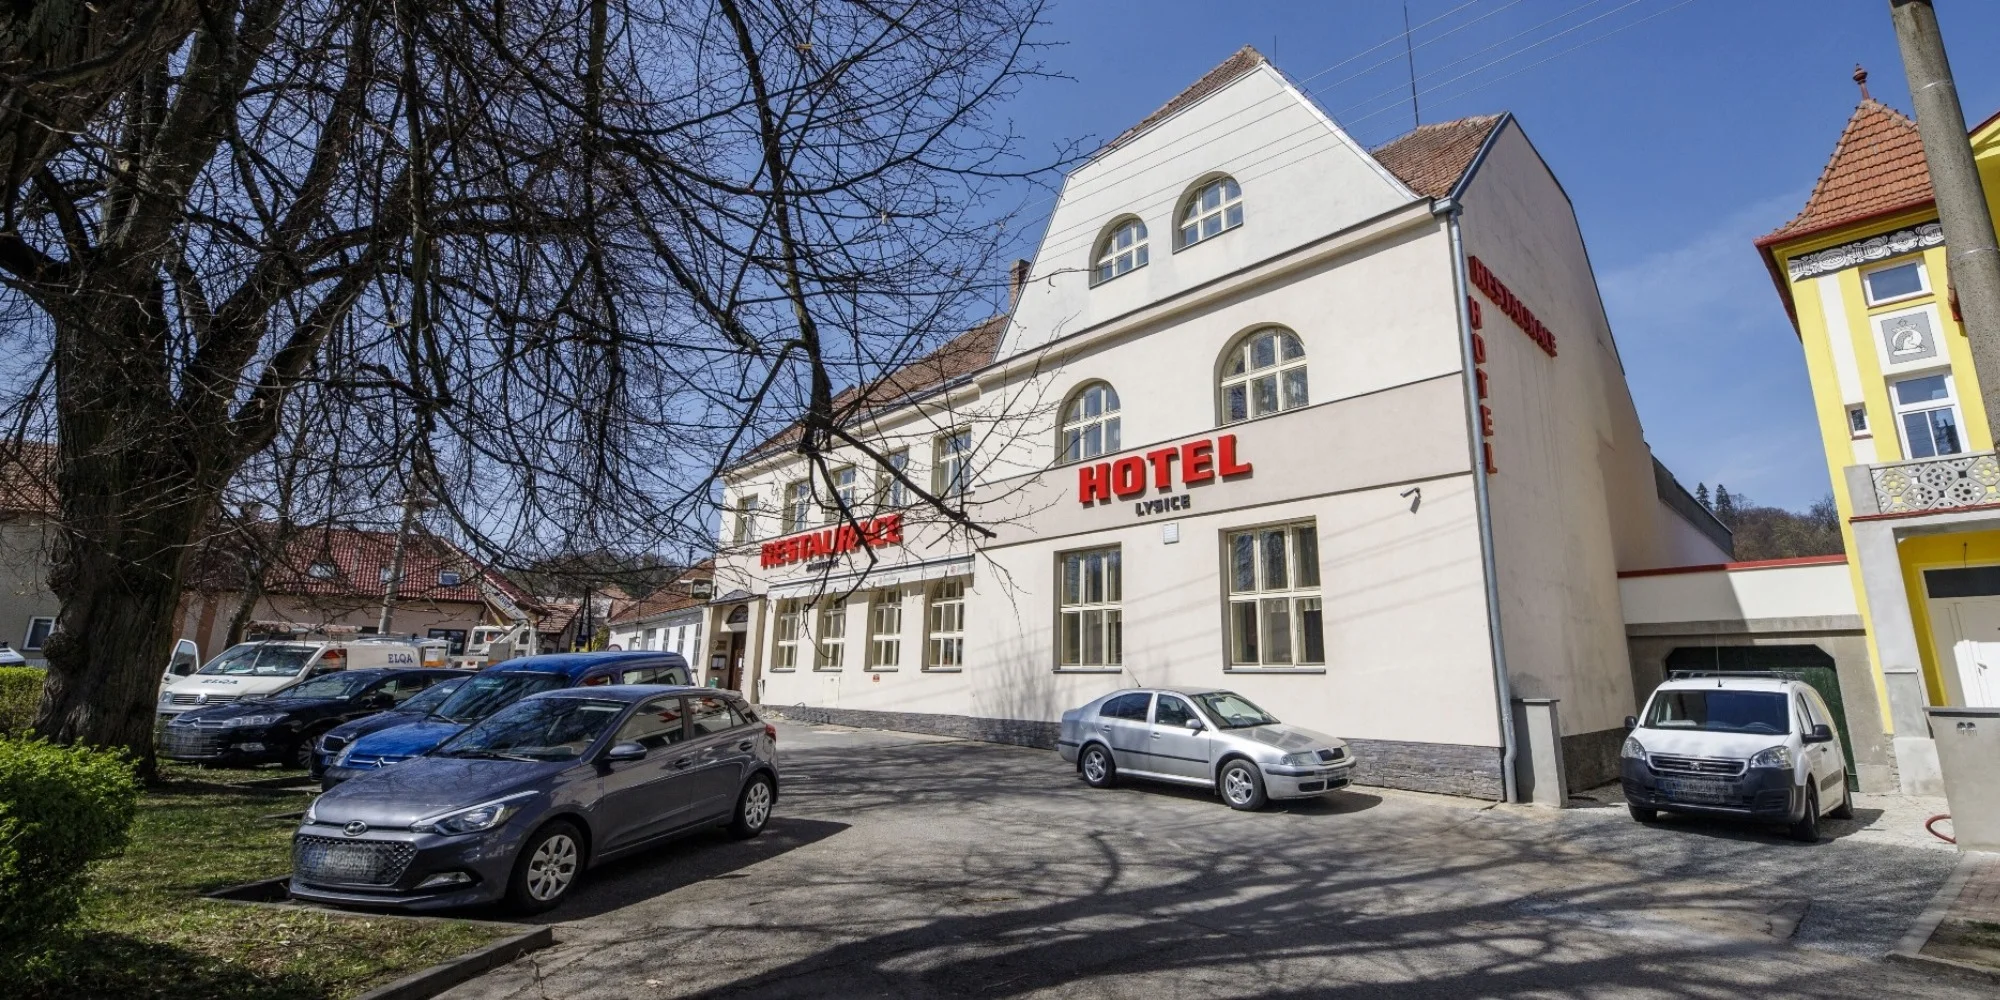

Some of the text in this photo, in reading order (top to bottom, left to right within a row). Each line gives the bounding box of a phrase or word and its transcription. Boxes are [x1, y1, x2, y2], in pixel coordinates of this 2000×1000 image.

[1467, 256, 1558, 358] RESTAURACE
[1468, 295, 1497, 474] HOTEL
[1079, 434, 1253, 506] HOTEL
[1135, 494, 1191, 517] LYSICE
[388, 653, 413, 664] ELQA
